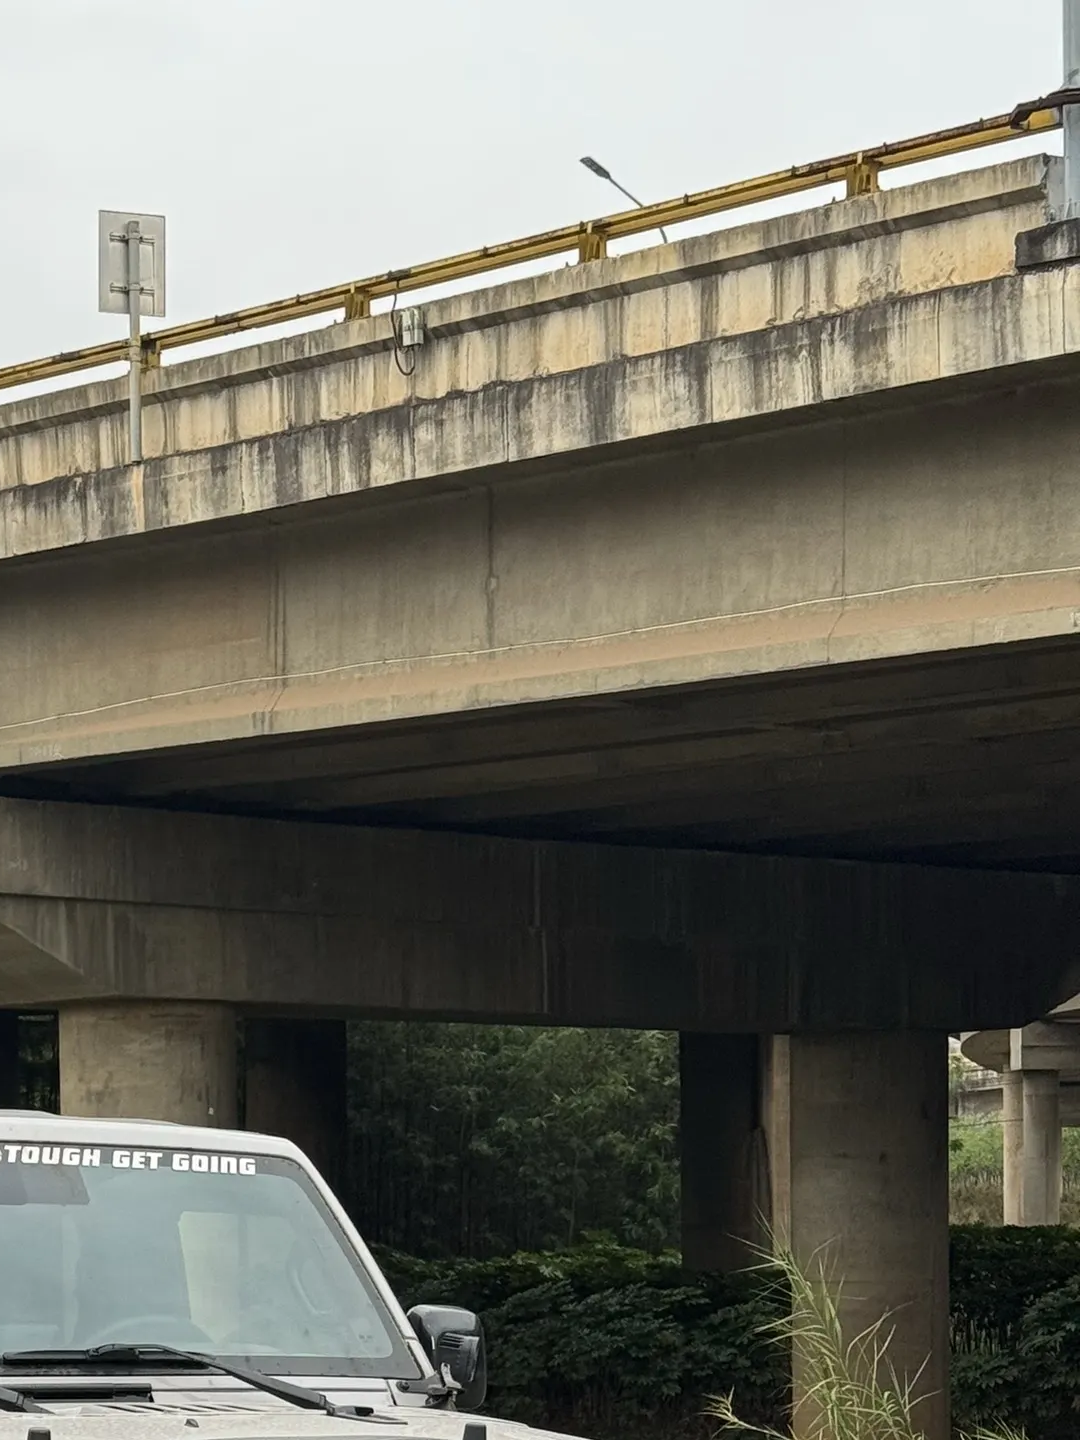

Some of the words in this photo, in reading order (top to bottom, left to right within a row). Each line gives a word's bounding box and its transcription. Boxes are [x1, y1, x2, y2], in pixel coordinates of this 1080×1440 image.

[4, 1145, 101, 1167] TOUGH
[112, 1151, 163, 1170] GET
[172, 1154, 257, 1176] GOING
